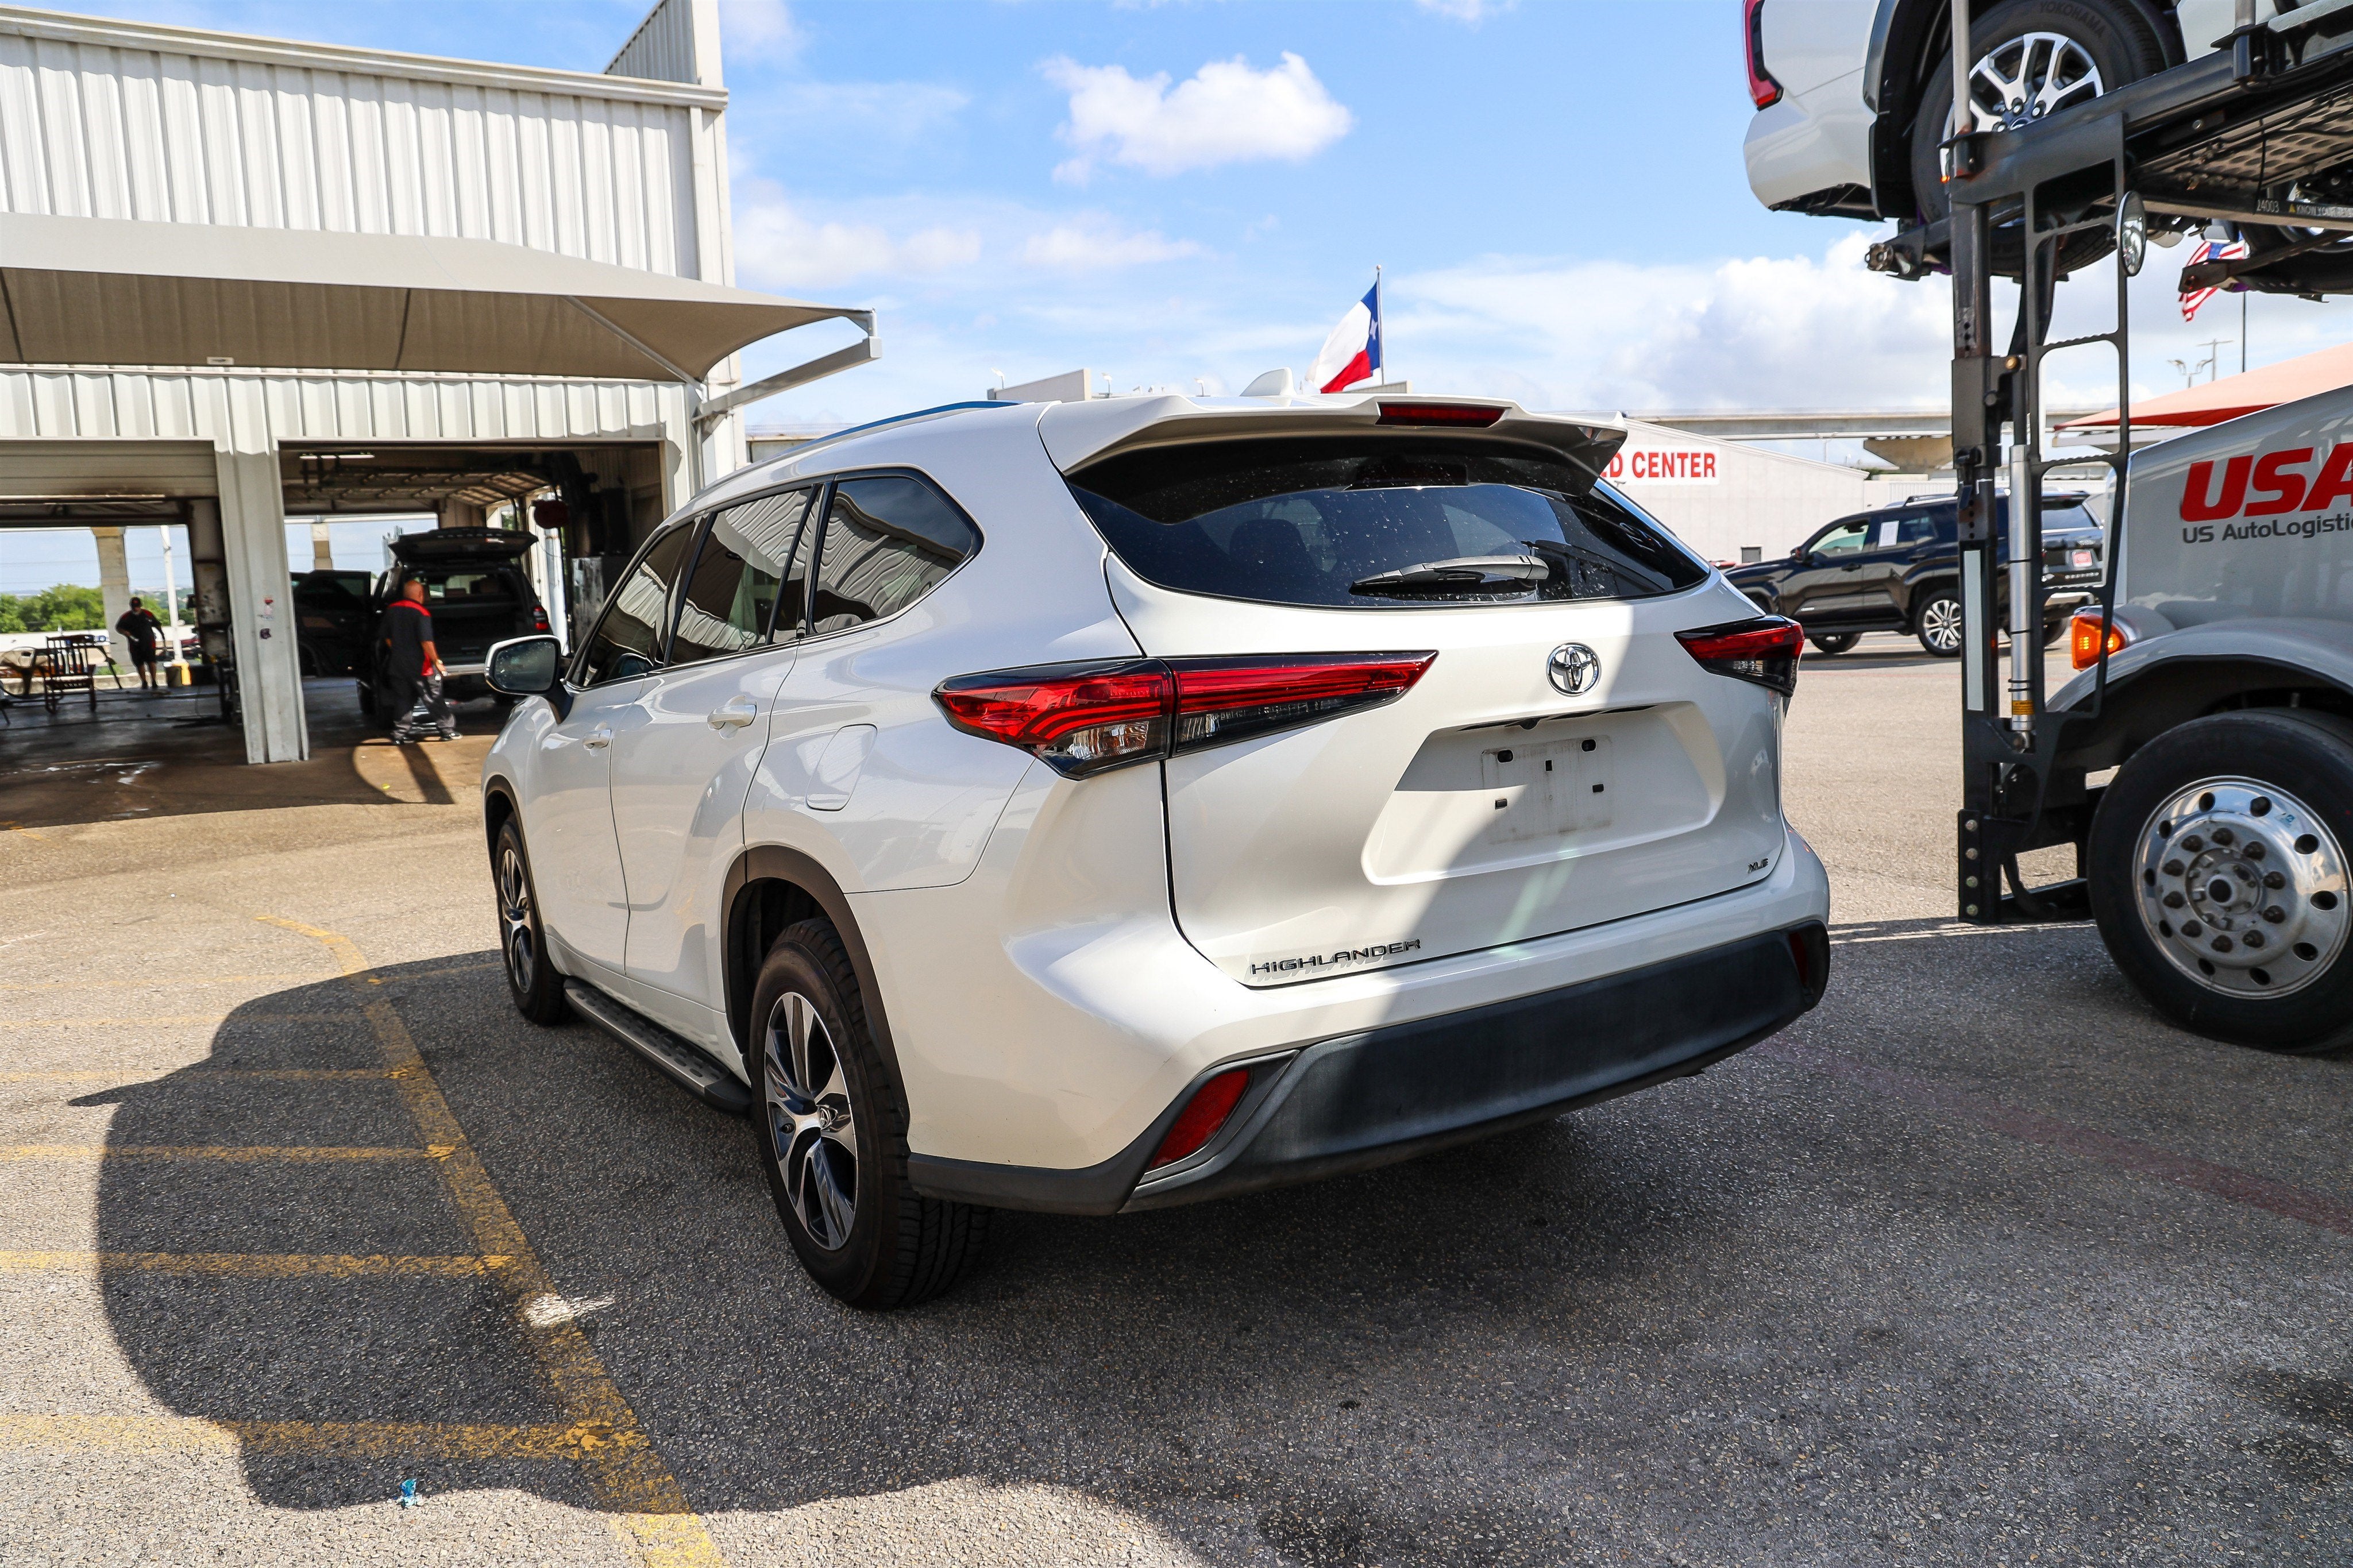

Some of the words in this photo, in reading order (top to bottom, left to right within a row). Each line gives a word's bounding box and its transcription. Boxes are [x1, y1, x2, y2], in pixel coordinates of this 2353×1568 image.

[2040, 1, 2107, 38] YOKOHAMA
[2256, 199, 2279, 213] 24003
[1599, 453, 1623, 478] D
[1631, 451, 1716, 478] CENTER
[2180, 442, 2353, 522] USA
[2182, 525, 2215, 544] US
[2221, 512, 2353, 541] AutoLogisti
[1747, 858, 1769, 874] XLE
[1250, 938, 1422, 975] HIGHLANDER
